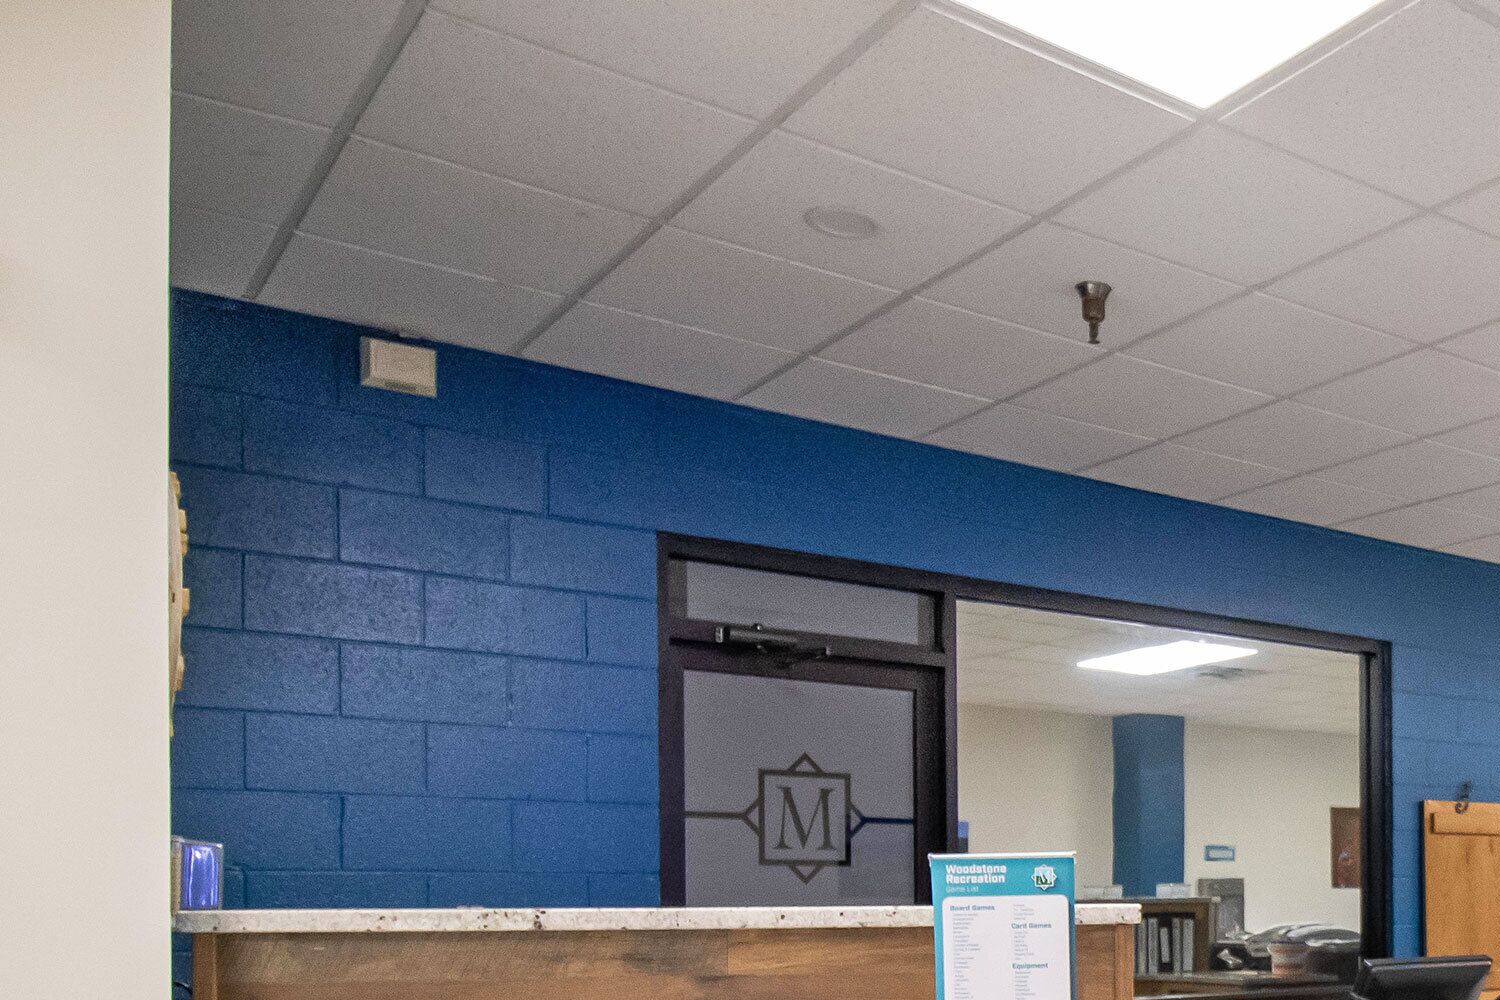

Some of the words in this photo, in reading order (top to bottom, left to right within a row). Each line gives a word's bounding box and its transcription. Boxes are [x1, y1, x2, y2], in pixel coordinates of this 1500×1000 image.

[774, 786, 837, 851] M
[945, 864, 1008, 874] Woodstone
[946, 873, 1006, 884] Recreation
